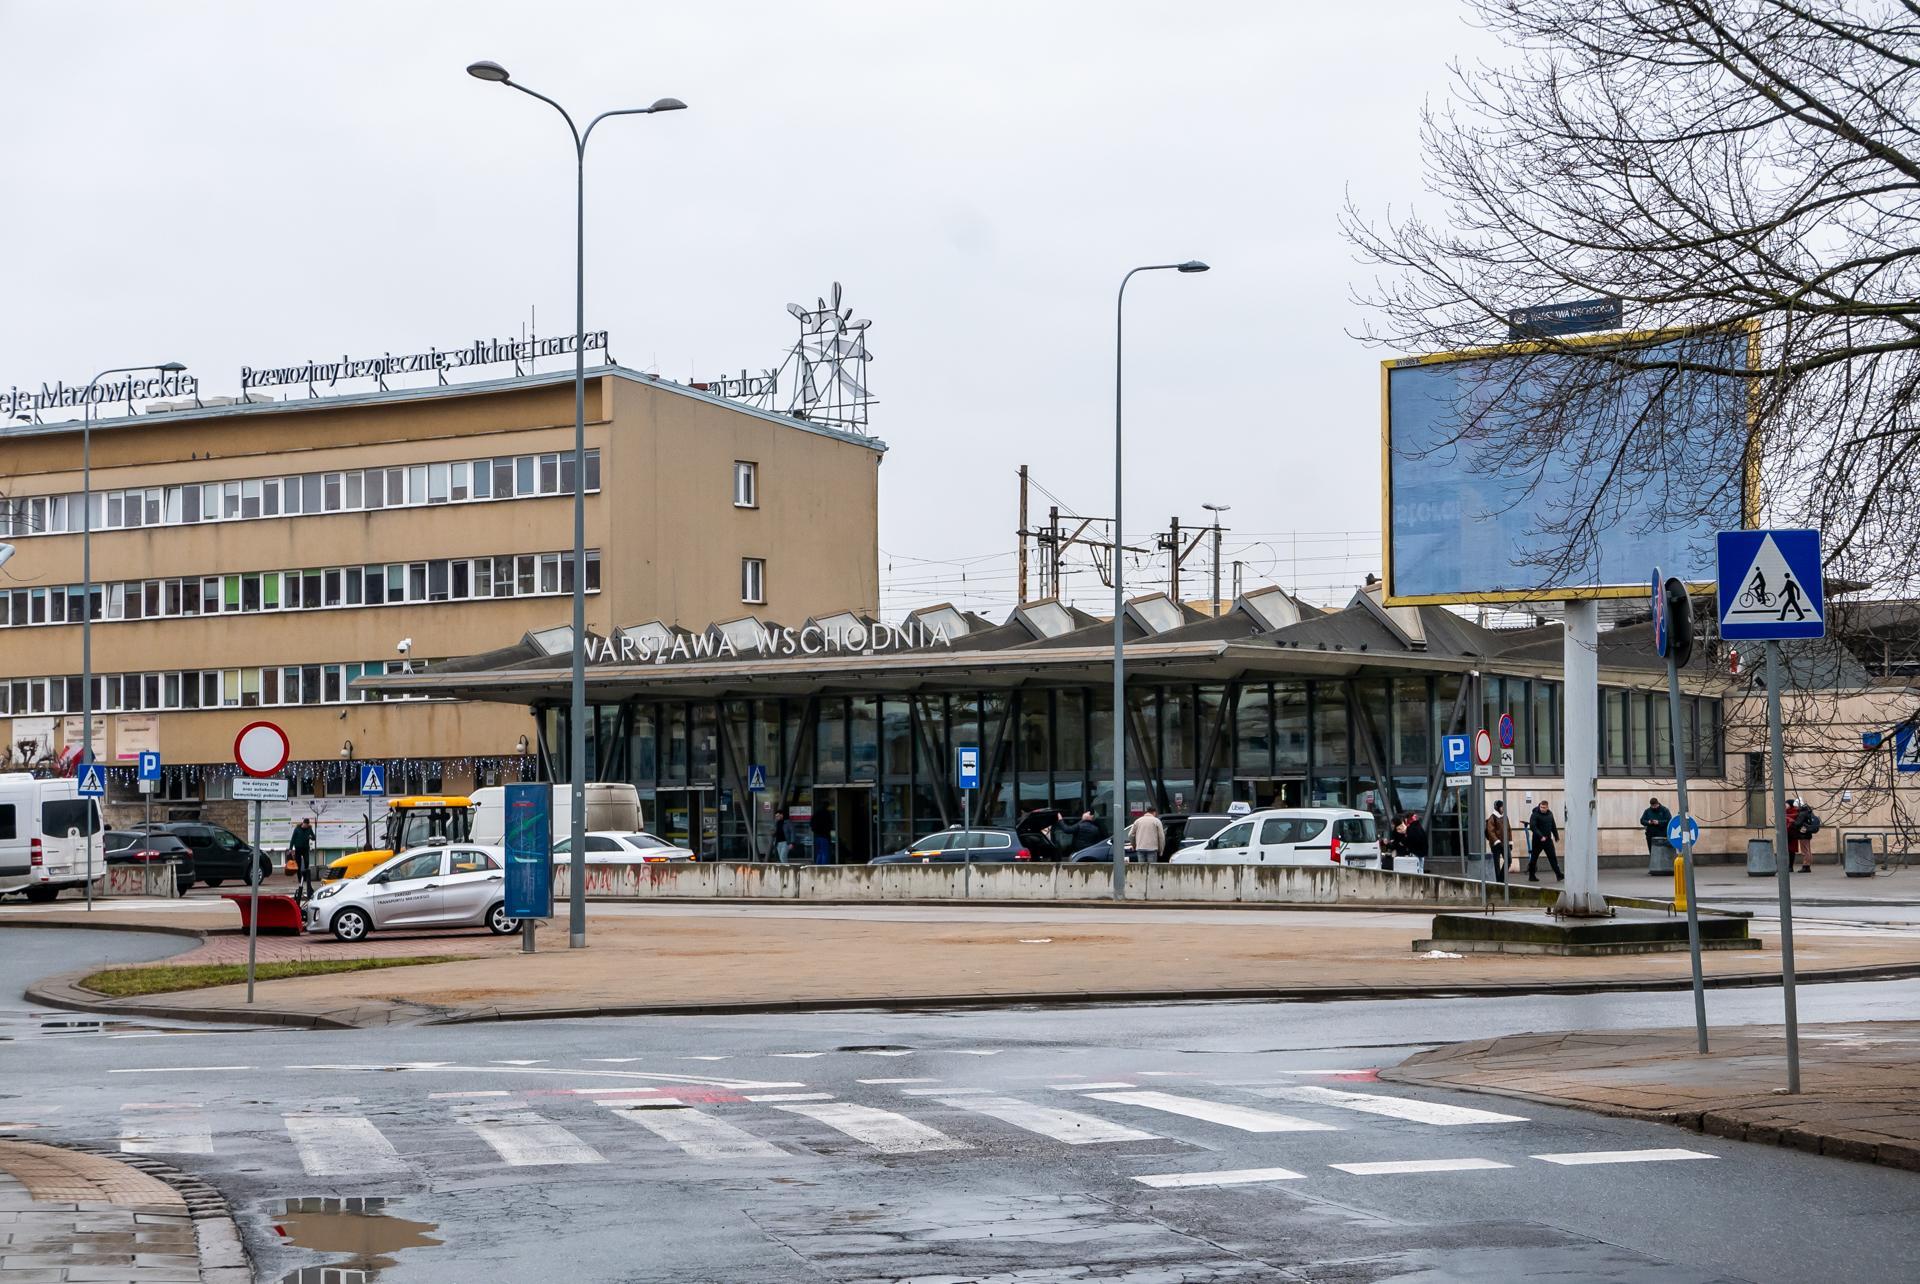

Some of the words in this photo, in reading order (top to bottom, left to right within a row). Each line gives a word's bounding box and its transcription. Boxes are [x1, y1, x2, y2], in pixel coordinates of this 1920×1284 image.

[241, 360, 342, 388] Przewozimy
[343, 347, 451, 382] bezpiecznie,
[453, 337, 525, 367] solidnie
[539, 337, 563, 356] na
[40, 371, 195, 410] Mazowieckie
[584, 632, 738, 662] WARSZAWA
[754, 621, 952, 655] WSCHODNIA
[143, 754, 156, 776] P
[1448, 738, 1465, 762] P
